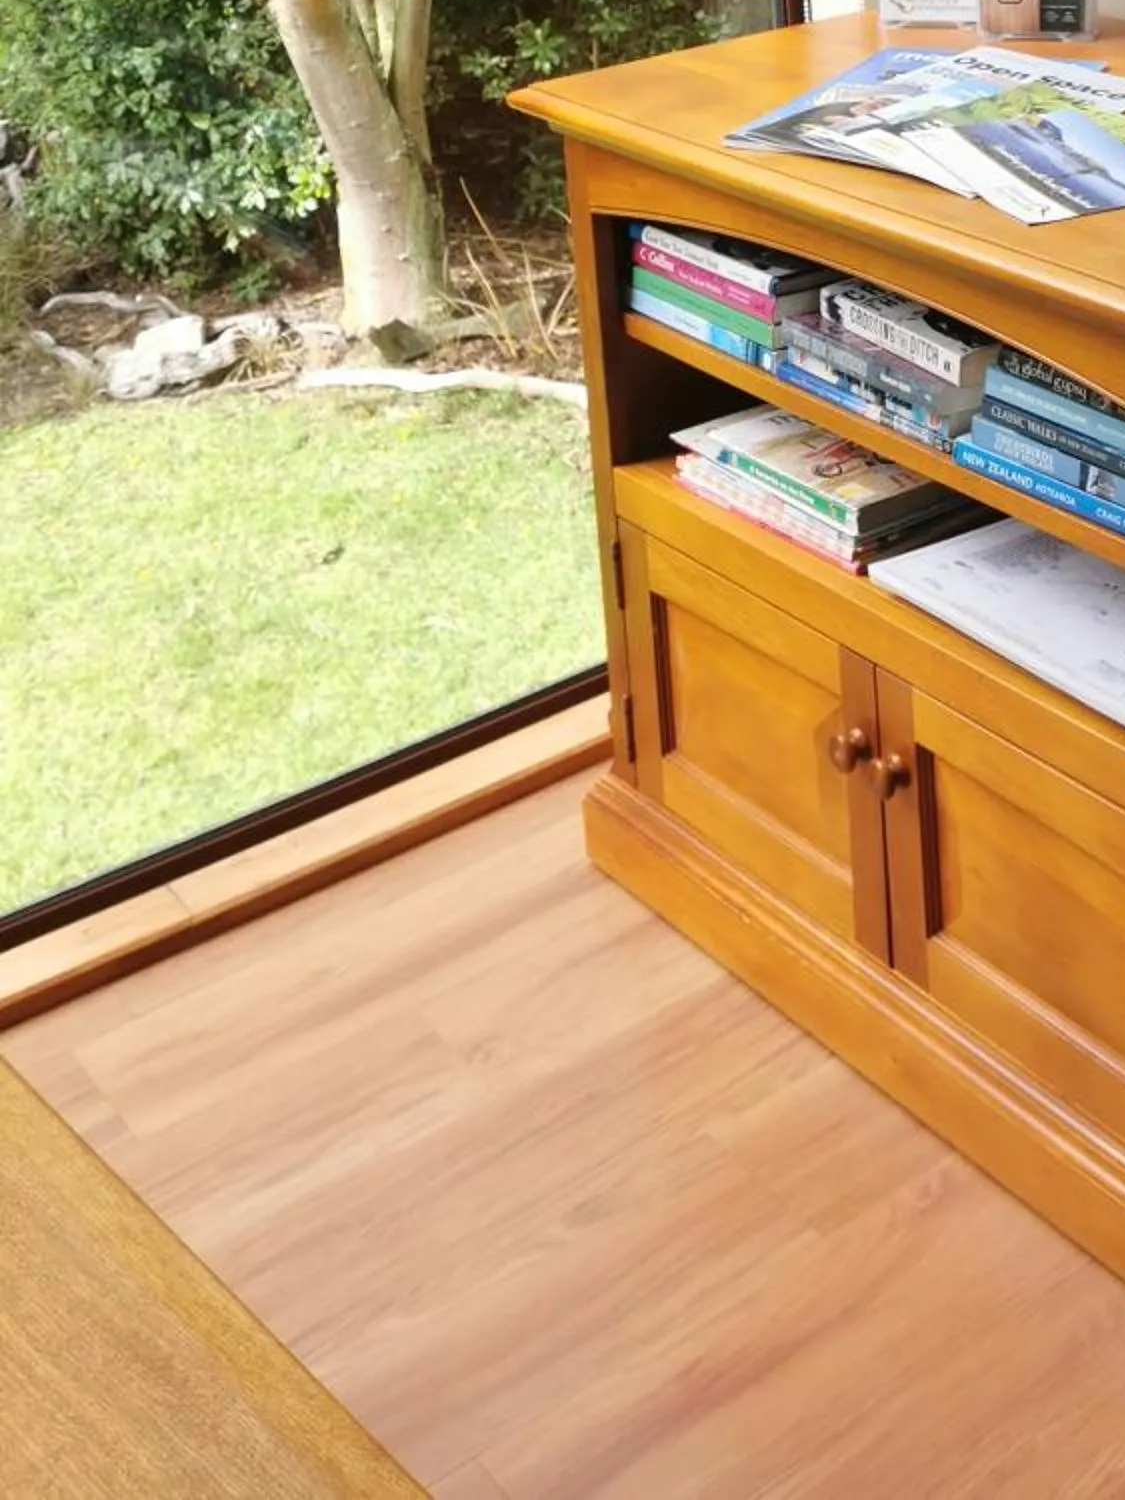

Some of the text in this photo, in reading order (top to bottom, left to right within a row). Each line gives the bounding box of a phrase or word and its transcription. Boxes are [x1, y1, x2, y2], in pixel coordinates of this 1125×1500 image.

[953, 56, 1030, 81] Open
[850, 304, 896, 344] CROSSING
[909, 333, 940, 366] DITCH
[1021, 356, 1088, 402] global gypsy
[991, 404, 1026, 429] CLASSIC
[1027, 418, 1057, 441] WALKS
[963, 450, 985, 469] NEW
[987, 457, 1033, 491] ZEALAND
[1096, 506, 1122, 527] CRAIG
